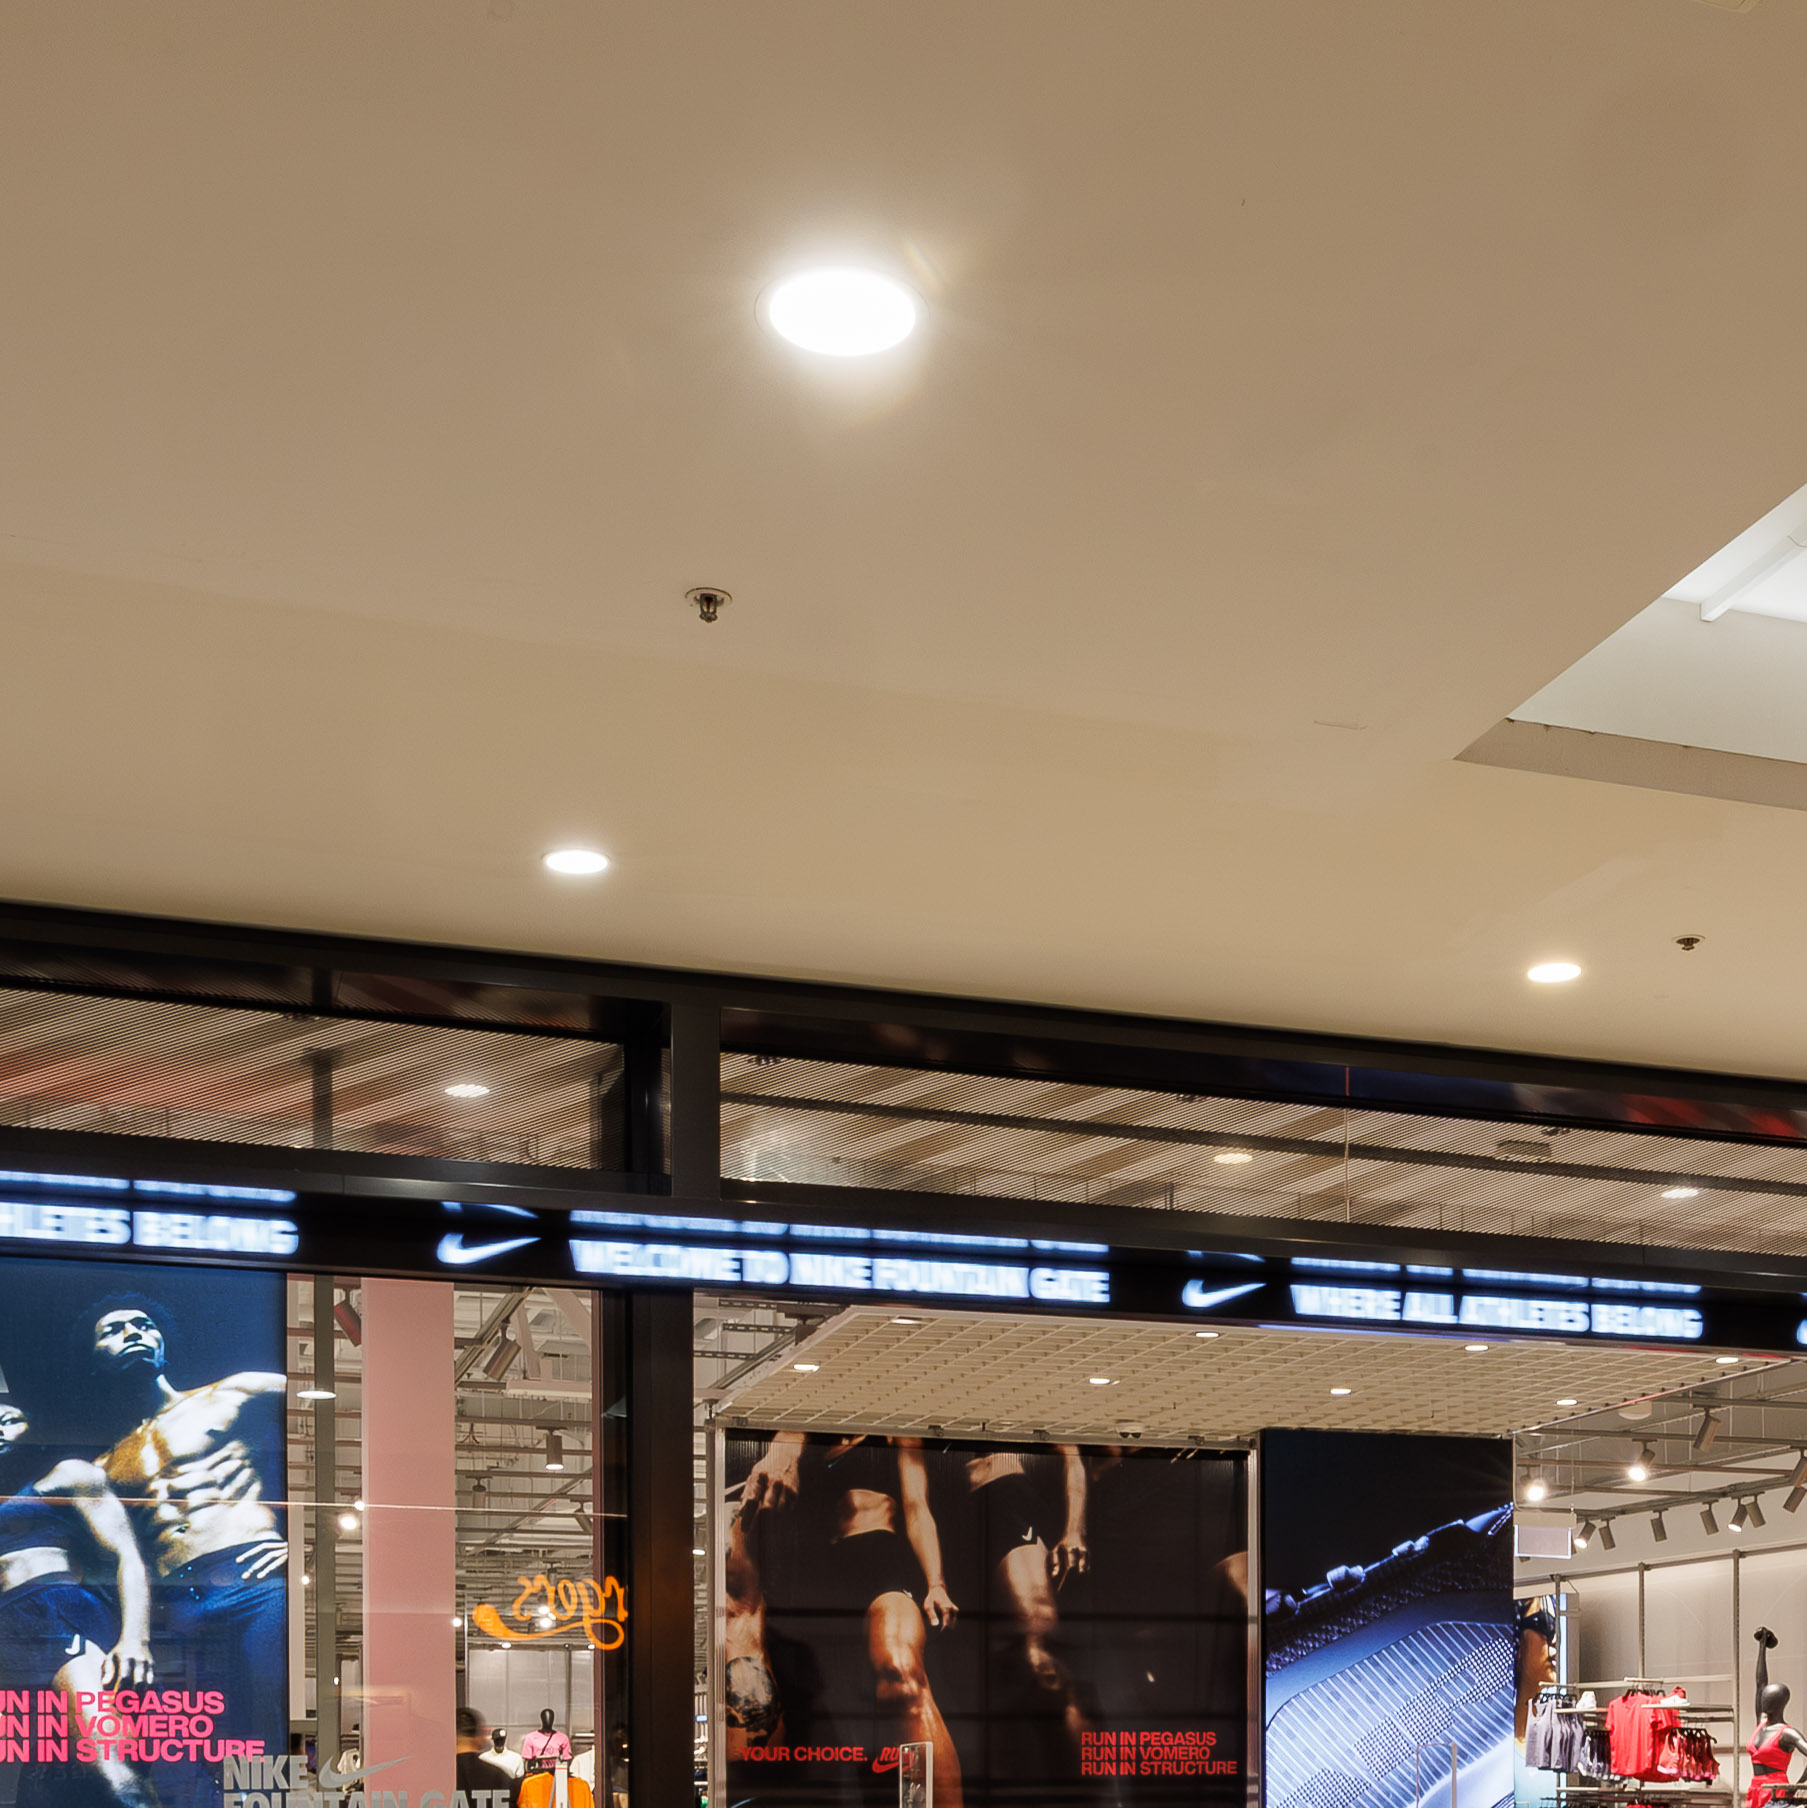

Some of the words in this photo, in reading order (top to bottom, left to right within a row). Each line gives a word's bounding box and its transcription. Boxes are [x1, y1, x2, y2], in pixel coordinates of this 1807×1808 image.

[133, 1211, 299, 1254] BELONG
[569, 1239, 742, 1282] WELCOME
[790, 1253, 872, 1289] NIKE
[873, 1258, 1029, 1298] FOUNTAIN
[1030, 1267, 1110, 1303] GATE
[1290, 1284, 1401, 1320] WHERE
[1401, 1292, 1458, 1323] ALL
[1458, 1296, 1590, 1332] ATHLETES
[1591, 1303, 1704, 1338] BELONG
[38, 1690, 68, 1714] IN
[75, 1690, 225, 1715] PEGASUS
[38, 1714, 68, 1738] IN
[74, 1714, 214, 1738] VOMERO
[38, 1739, 68, 1763] IN
[76, 1739, 265, 1763] STRUCTURE
[1081, 1731, 1117, 1747] RUN
[1120, 1731, 1137, 1747] IN
[1140, 1731, 1217, 1747] PEGASUS
[741, 1746, 790, 1762] YOUR
[794, 1746, 868, 1762] CHOICE.
[1081, 1746, 1117, 1761] RUN
[1120, 1746, 1137, 1761] IN
[1139, 1746, 1210, 1761] VOMERO
[224, 1755, 308, 1790] NIKE
[1081, 1761, 1117, 1776] RUN
[1120, 1761, 1136, 1776] IN
[1139, 1761, 1238, 1776] STRUCTURE
